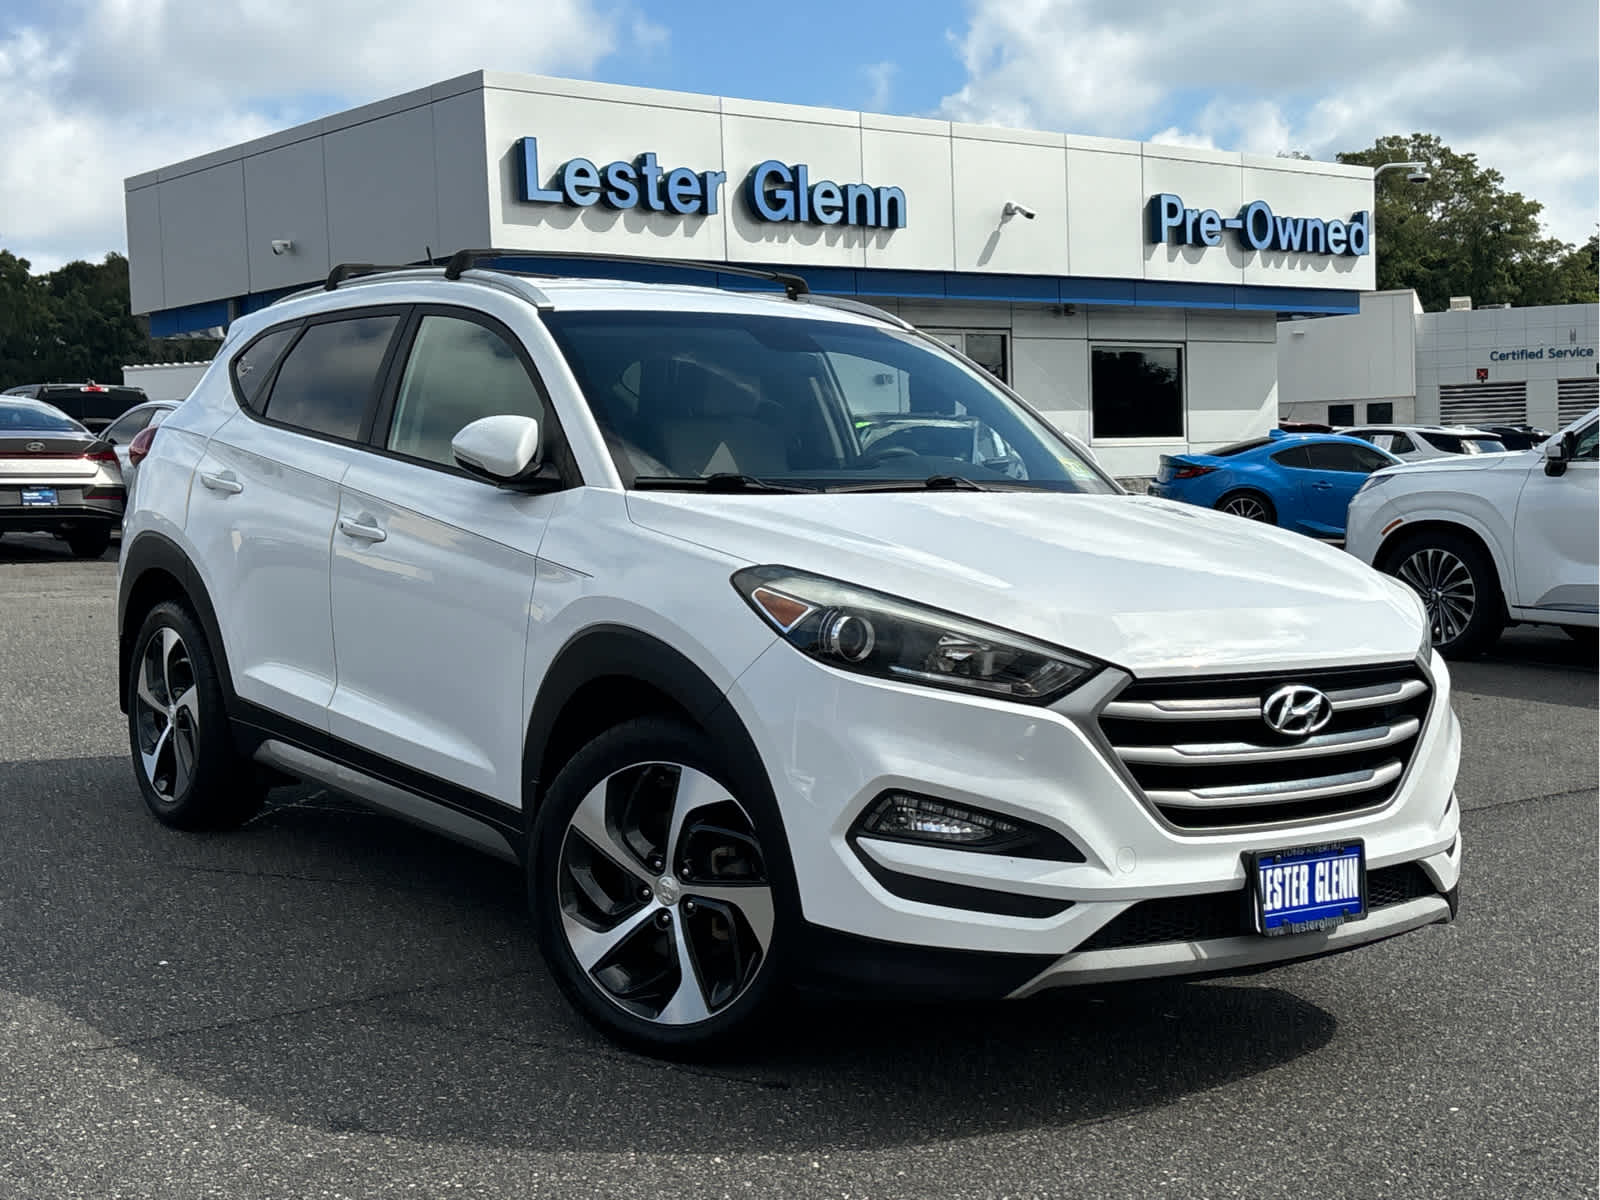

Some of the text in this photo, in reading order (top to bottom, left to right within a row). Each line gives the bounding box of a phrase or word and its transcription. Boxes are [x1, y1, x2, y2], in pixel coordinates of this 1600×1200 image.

[517, 136, 907, 229] Lester Glenn
[1151, 193, 1370, 256] Pre-Owned
[1490, 346, 1594, 361] Certified Service
[1315, 857, 1359, 903] GLENN
